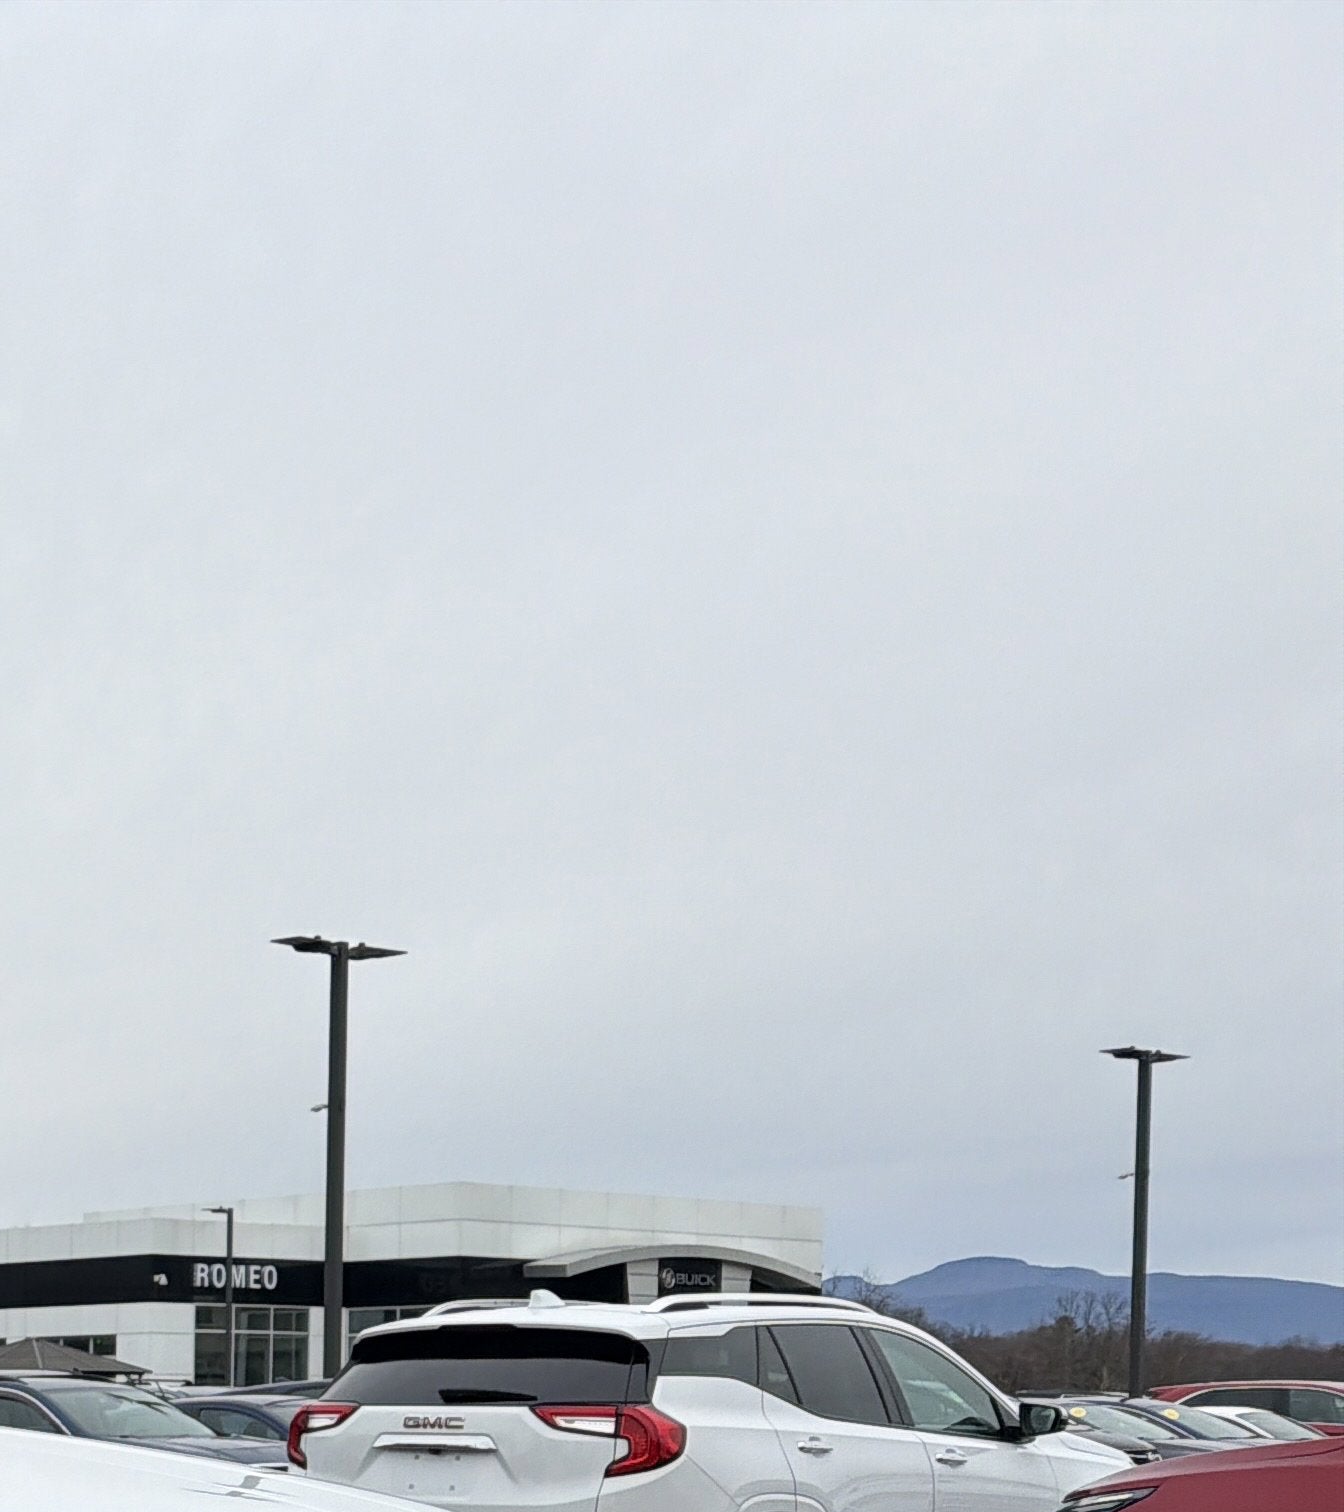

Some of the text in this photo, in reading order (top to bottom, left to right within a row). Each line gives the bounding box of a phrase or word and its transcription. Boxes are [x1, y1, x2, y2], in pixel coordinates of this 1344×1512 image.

[193, 1262, 278, 1290] ROMEO
[676, 1272, 716, 1287] BUICK
[403, 1416, 465, 1429] GMC
